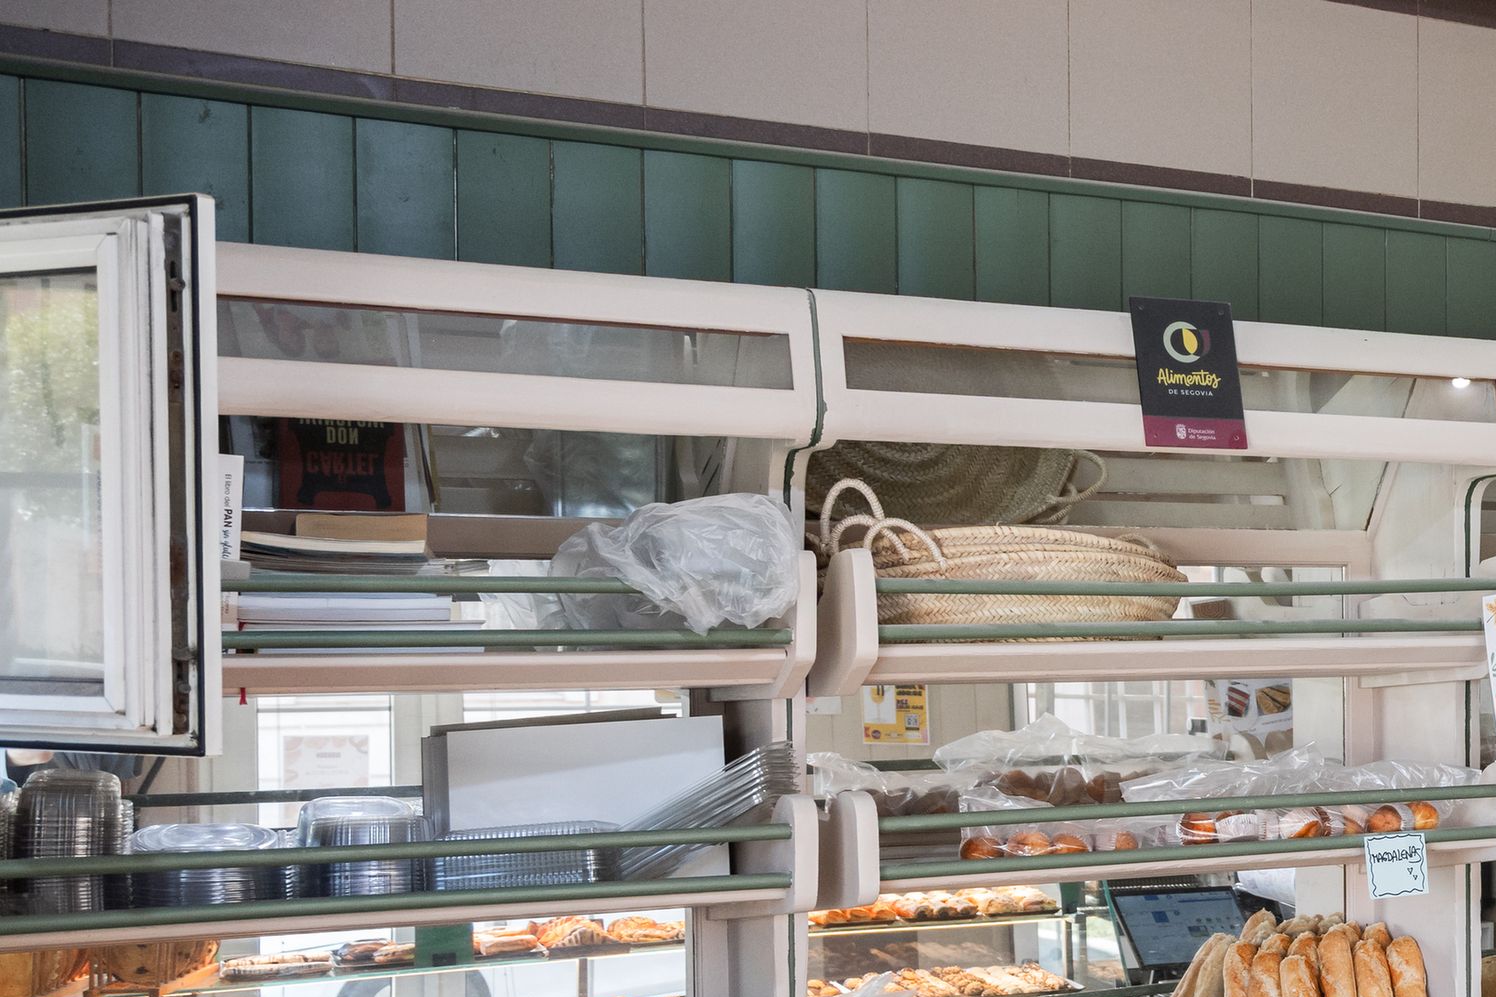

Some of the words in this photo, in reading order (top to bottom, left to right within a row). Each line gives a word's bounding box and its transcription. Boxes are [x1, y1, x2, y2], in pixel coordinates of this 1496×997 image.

[1157, 368, 1222, 388] Alimentos
[1181, 389, 1214, 397] SEGOVIA
[224, 509, 233, 528] PAN
[1372, 845, 1421, 863] MAGDALENAS
